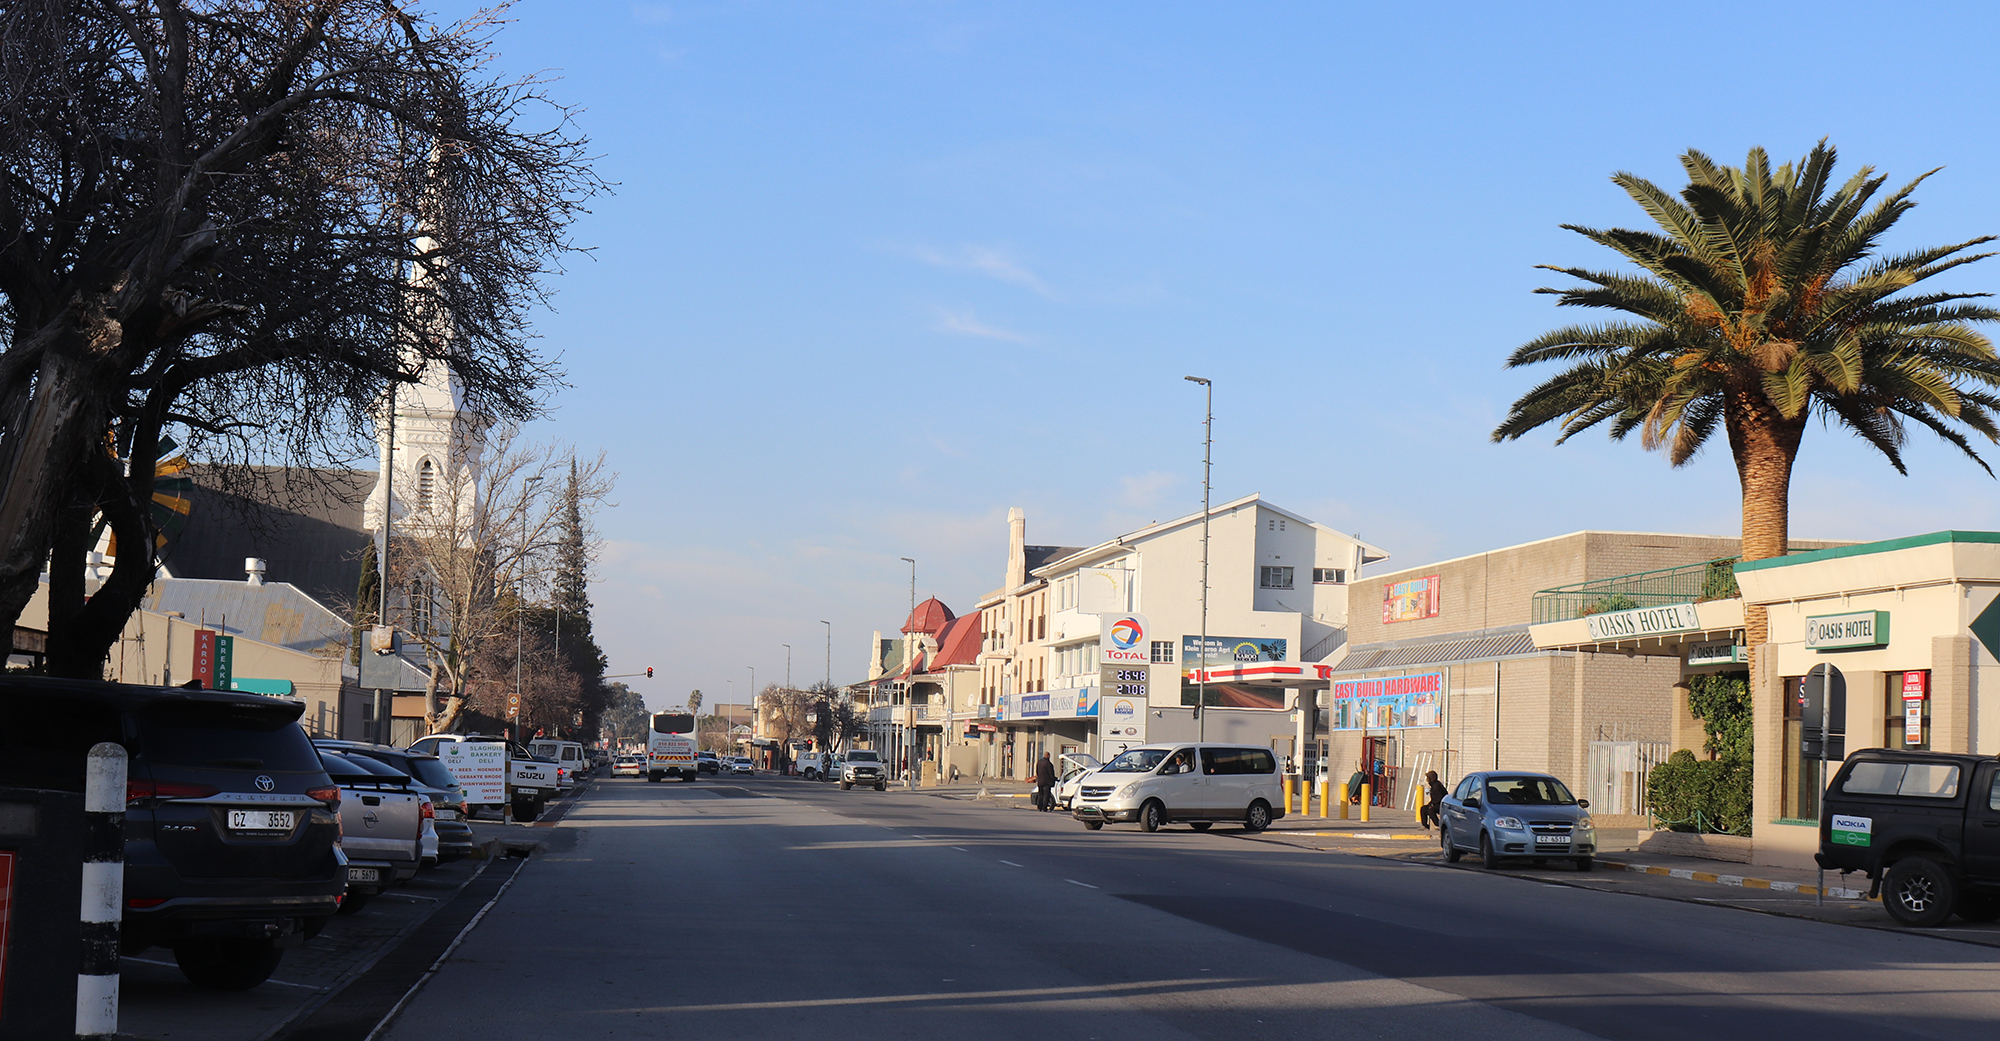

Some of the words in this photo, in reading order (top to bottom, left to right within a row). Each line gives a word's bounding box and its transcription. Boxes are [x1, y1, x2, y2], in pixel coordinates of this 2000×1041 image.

[1394, 582, 1409, 596] EASY
[1410, 579, 1428, 593] BUILD
[1599, 613, 1635, 636] OASIS
[1638, 607, 1684, 632] HOTEL
[1819, 622, 1843, 640] OASIS
[1845, 619, 1872, 638] HOTEL
[200, 634, 208, 673] KAROO
[1105, 650, 1147, 660] TOTAL
[1697, 644, 1714, 659] OASIS
[1335, 683, 1355, 699] EASY
[1356, 680, 1383, 697] BUILD
[1384, 674, 1440, 696] HARDWARE
[516, 771, 545, 780] ISUZU
[233, 812, 246, 827] CZ
[268, 813, 290, 828] 3552
[1836, 820, 1866, 828] NOKIA
[350, 869, 358, 880] CZ
